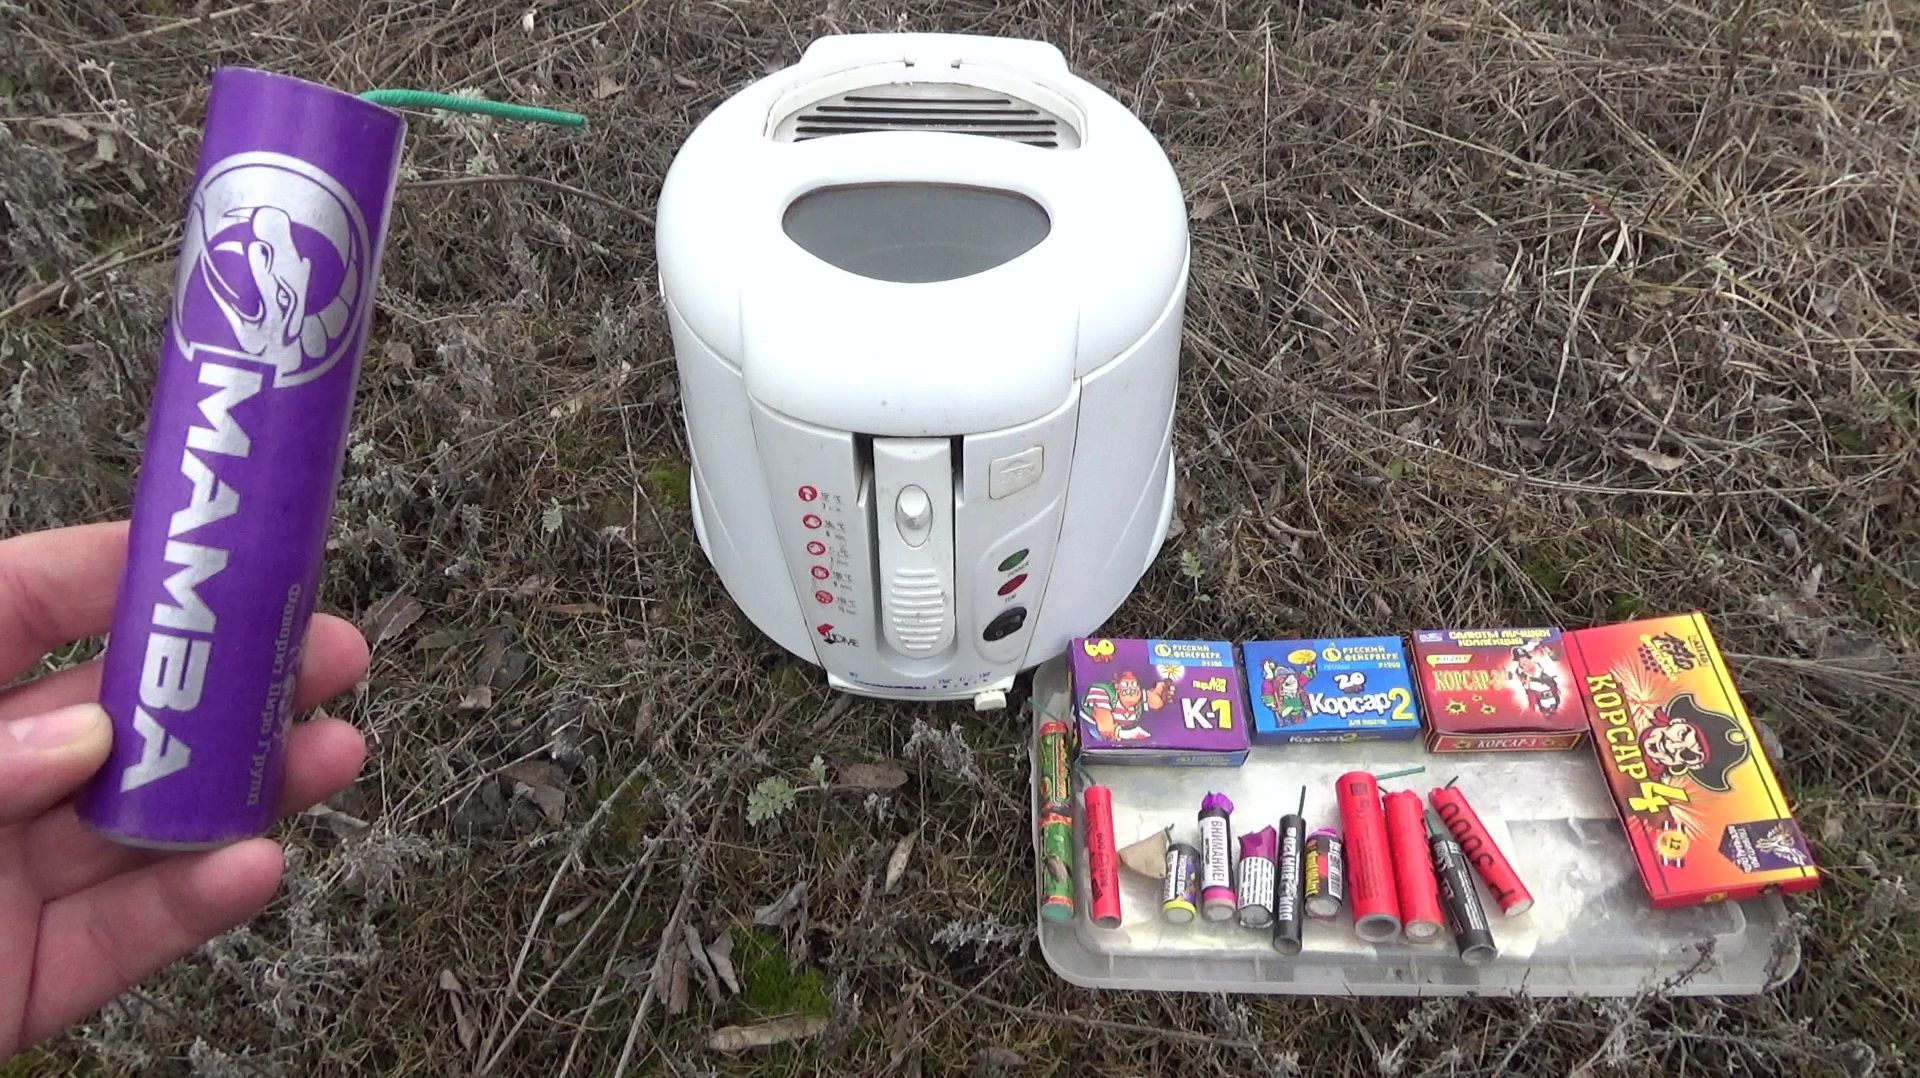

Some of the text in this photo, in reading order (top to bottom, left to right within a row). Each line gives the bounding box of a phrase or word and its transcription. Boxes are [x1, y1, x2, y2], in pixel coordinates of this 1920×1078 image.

[121, 360, 263, 793] MAMBA
[271, 583, 303, 676] Фаворит
[1084, 639, 1115, 657] 60
[1342, 645, 1386, 654] РУССКИЙ
[259, 681, 283, 735] Пиро
[1308, 687, 1415, 720] Корсар 2
[1334, 672, 1365, 690] 20
[1181, 697, 1232, 730] К-1
[1586, 673, 1691, 813] КОРСАР 4
[246, 739, 272, 808] Групп
[1211, 820, 1226, 882] ВНИМАНИЕ!
